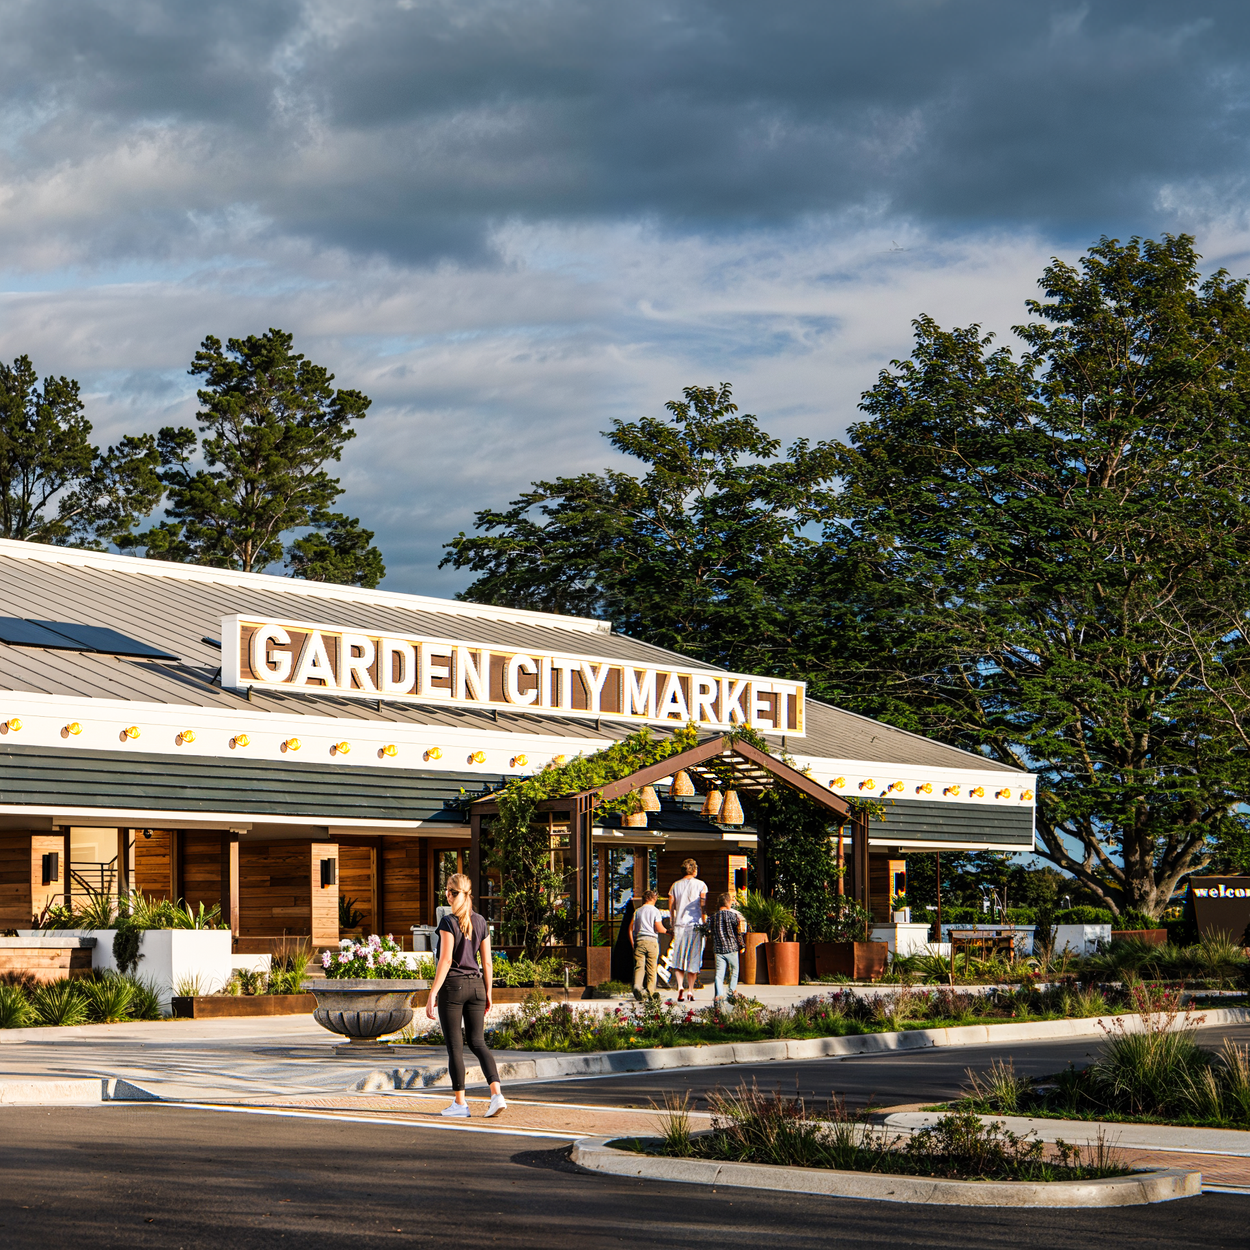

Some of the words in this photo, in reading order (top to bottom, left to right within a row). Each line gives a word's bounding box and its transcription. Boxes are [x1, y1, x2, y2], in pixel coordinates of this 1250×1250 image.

[251, 624, 490, 701] GARDEN
[505, 653, 610, 713] CITY
[622, 664, 797, 731] MARKET
